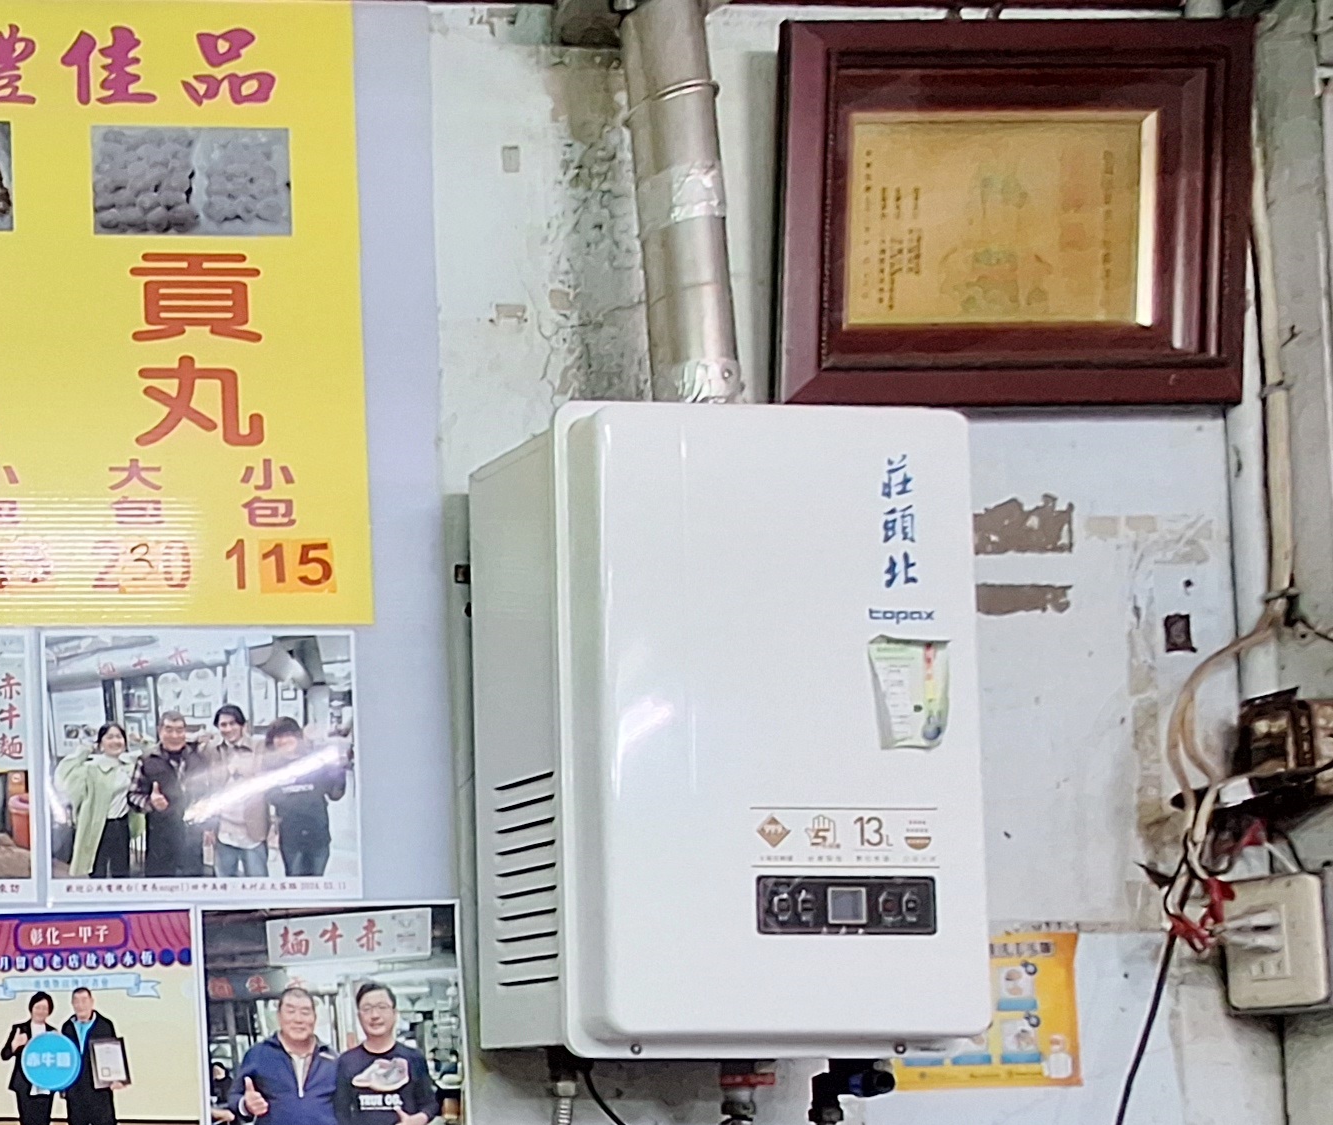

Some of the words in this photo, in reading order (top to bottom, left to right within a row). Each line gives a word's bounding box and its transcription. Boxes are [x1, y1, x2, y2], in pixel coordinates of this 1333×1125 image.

[129, 253, 264, 447] 貢丸
[107, 459, 165, 527] 大包
[240, 459, 297, 528] 小包
[881, 454, 919, 589] 莊頭北
[225, 540, 333, 591] 115
[869, 608, 935, 625] topax
[30, 925, 109, 946] 彰化一甲子
